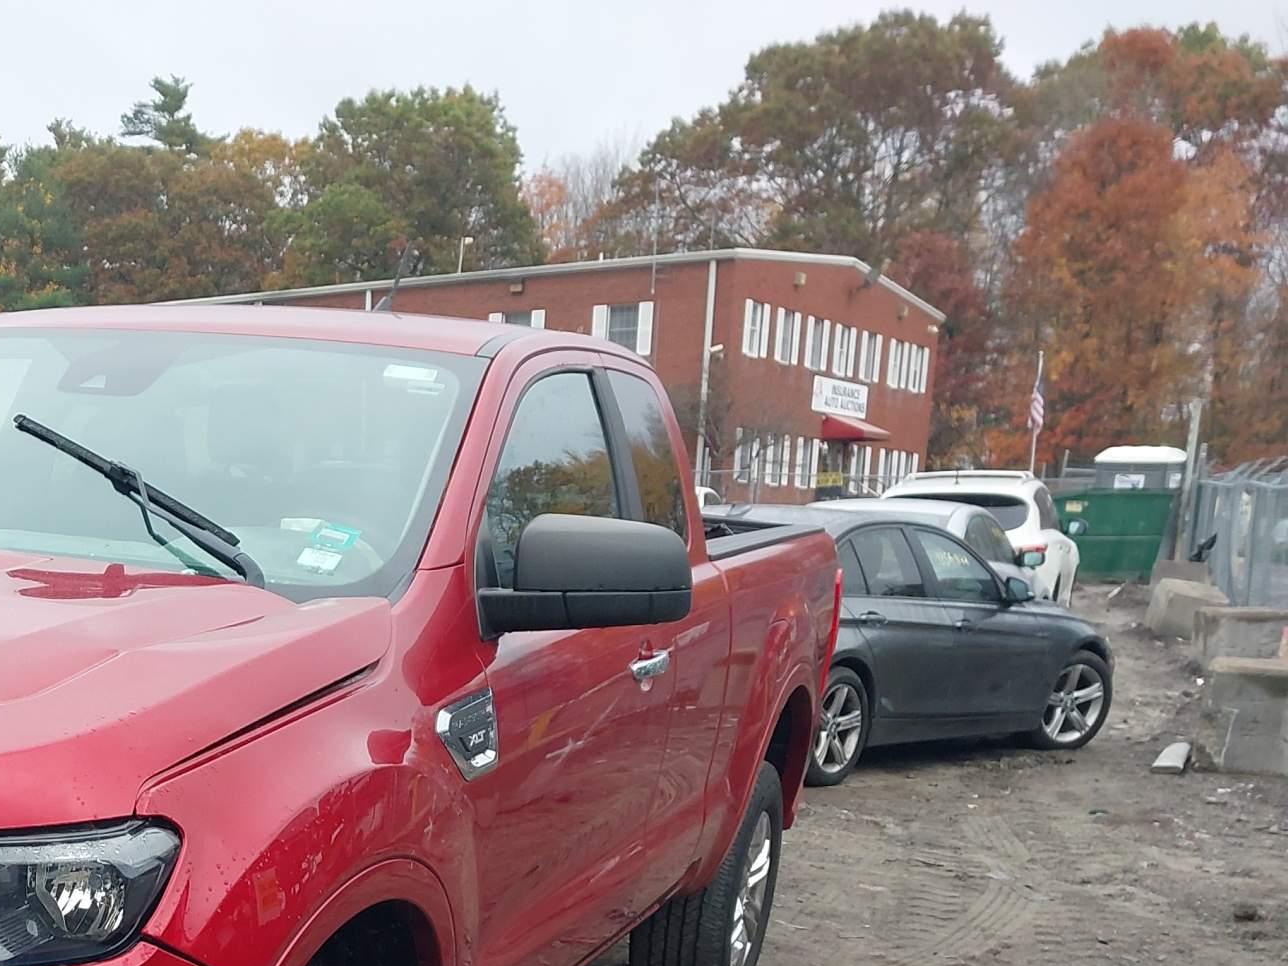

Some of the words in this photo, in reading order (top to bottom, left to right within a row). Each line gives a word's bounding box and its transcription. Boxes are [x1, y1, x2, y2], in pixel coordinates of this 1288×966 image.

[831, 383, 861, 400] INSURANCE
[824, 395, 840, 409] AUTO
[840, 397, 865, 414] AUCTIONS
[468, 729, 486, 747] XLT
